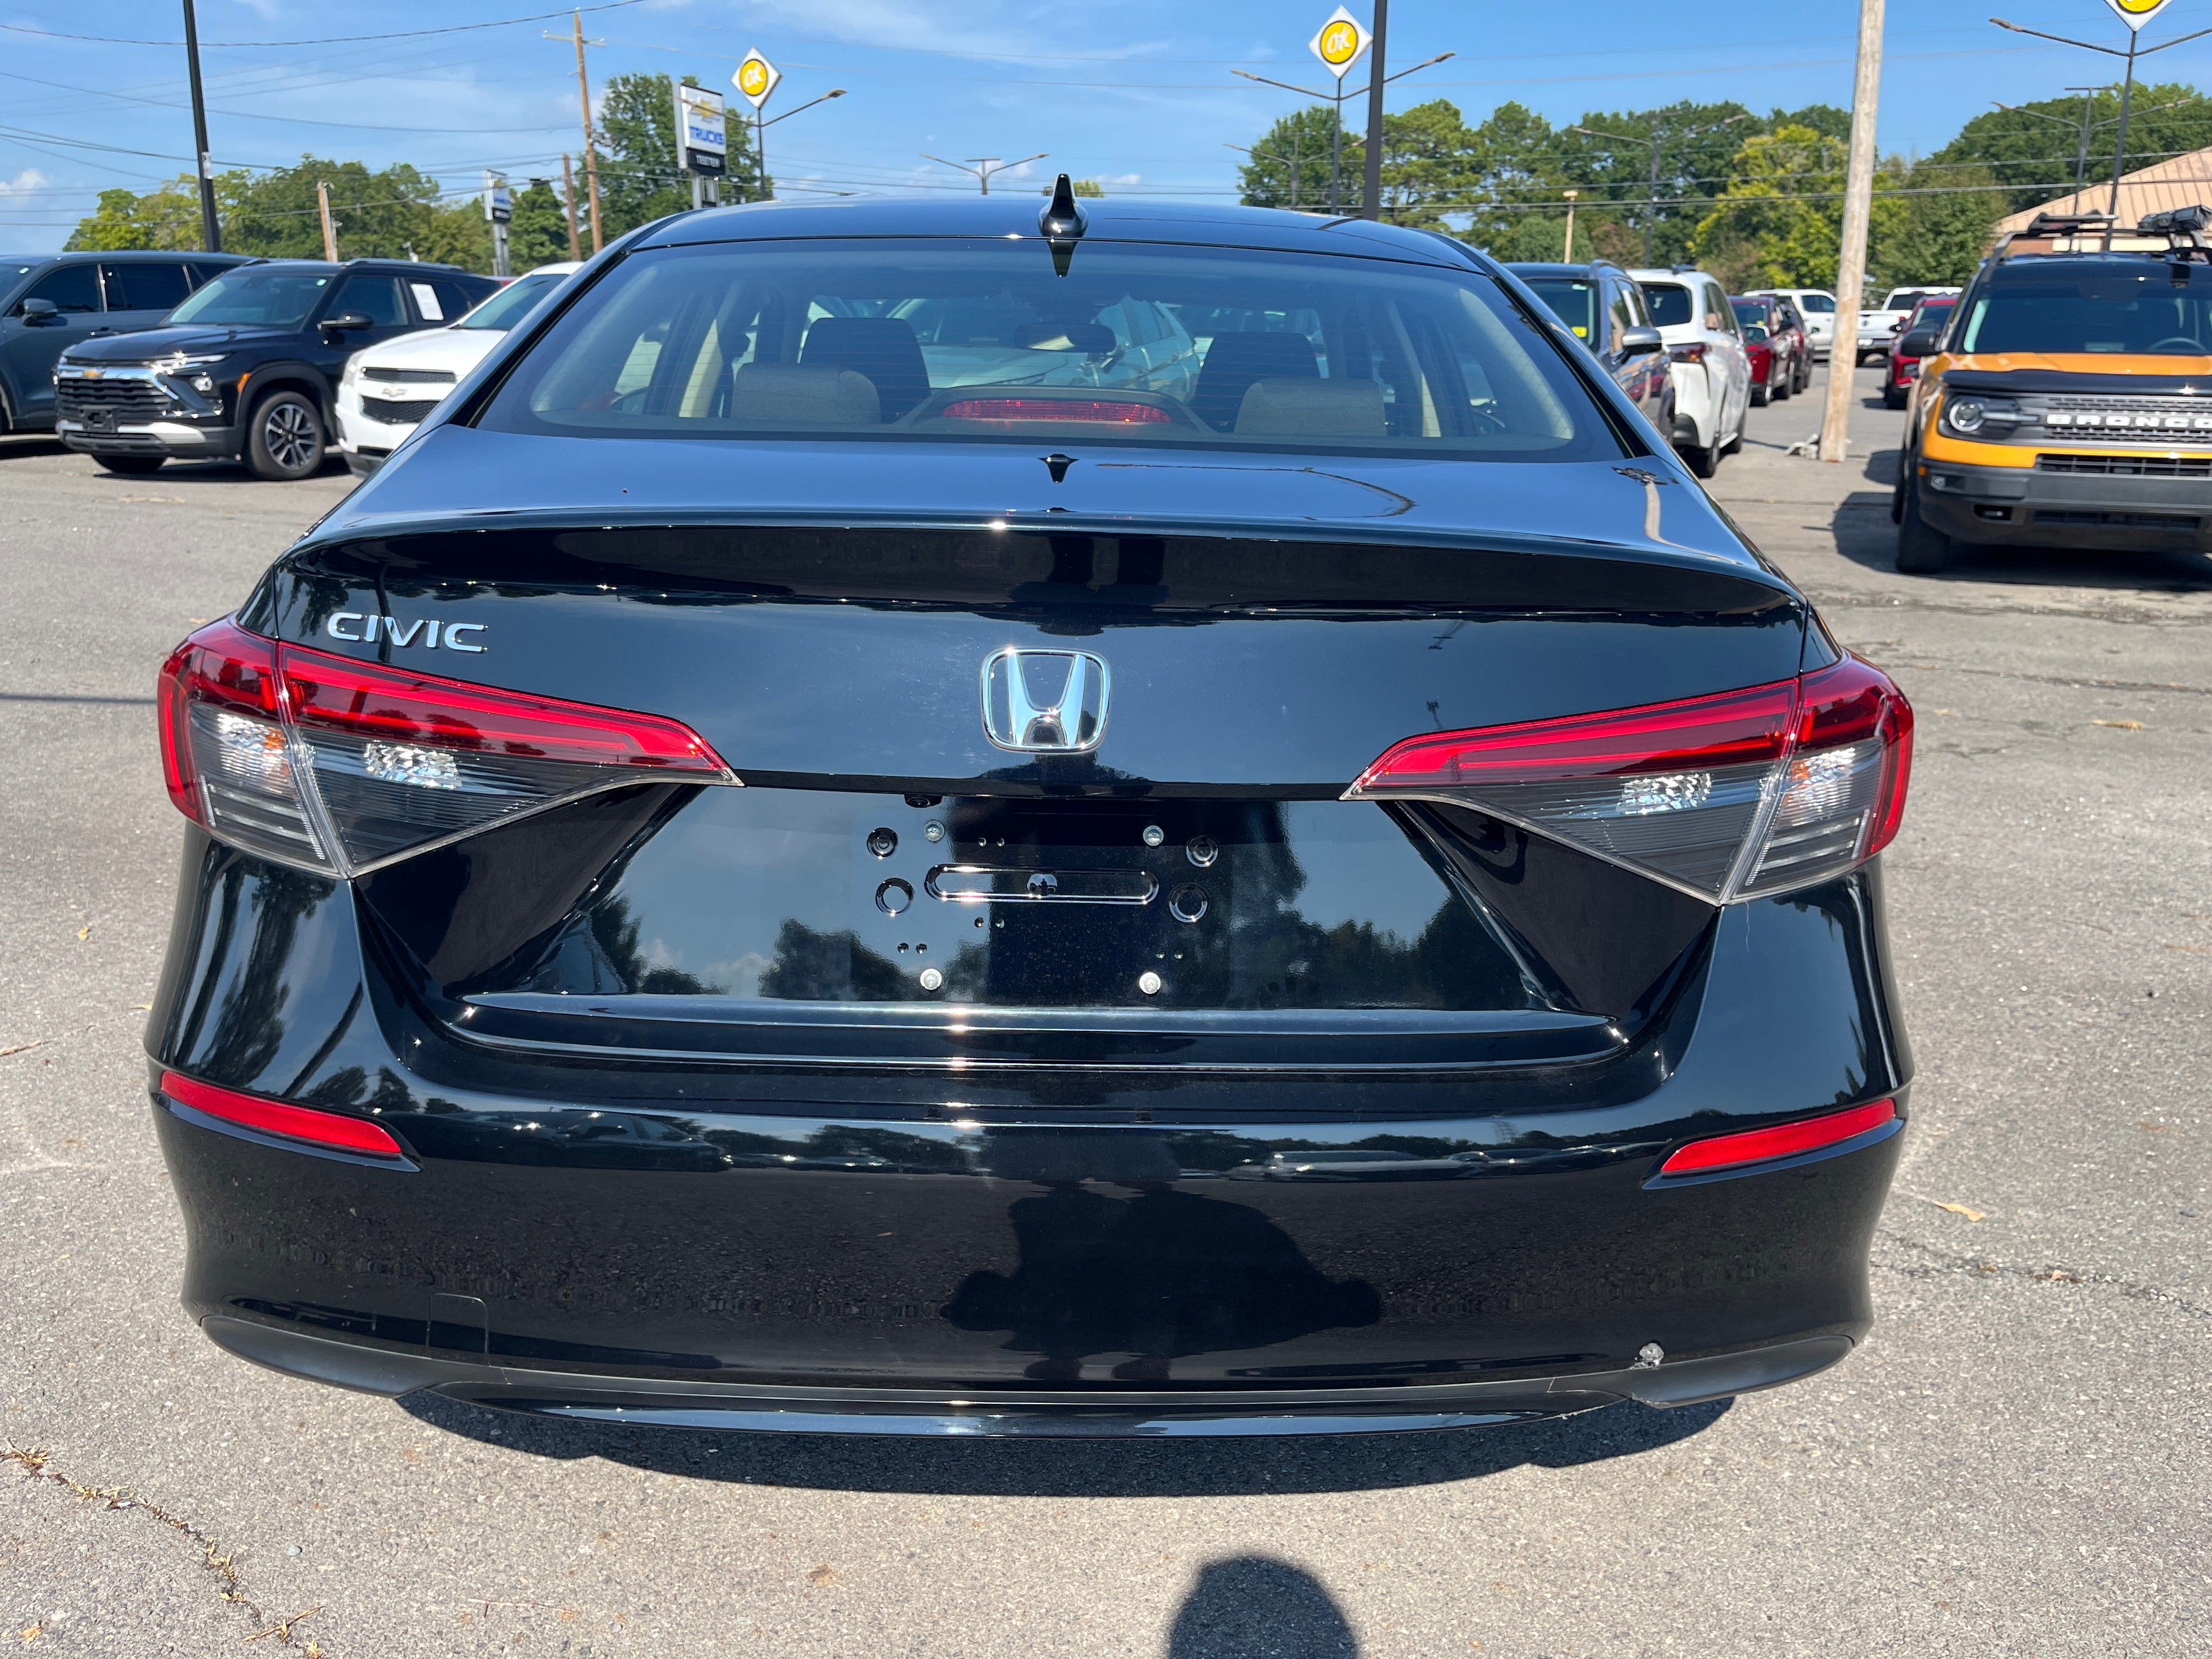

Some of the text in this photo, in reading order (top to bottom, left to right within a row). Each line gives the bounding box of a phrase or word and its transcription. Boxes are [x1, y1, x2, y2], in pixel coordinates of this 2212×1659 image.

[1326, 25, 1352, 54] OK
[743, 62, 765, 88] OK
[2046, 413, 2212, 429] BRONCO
[328, 612, 487, 652] CIVIC
